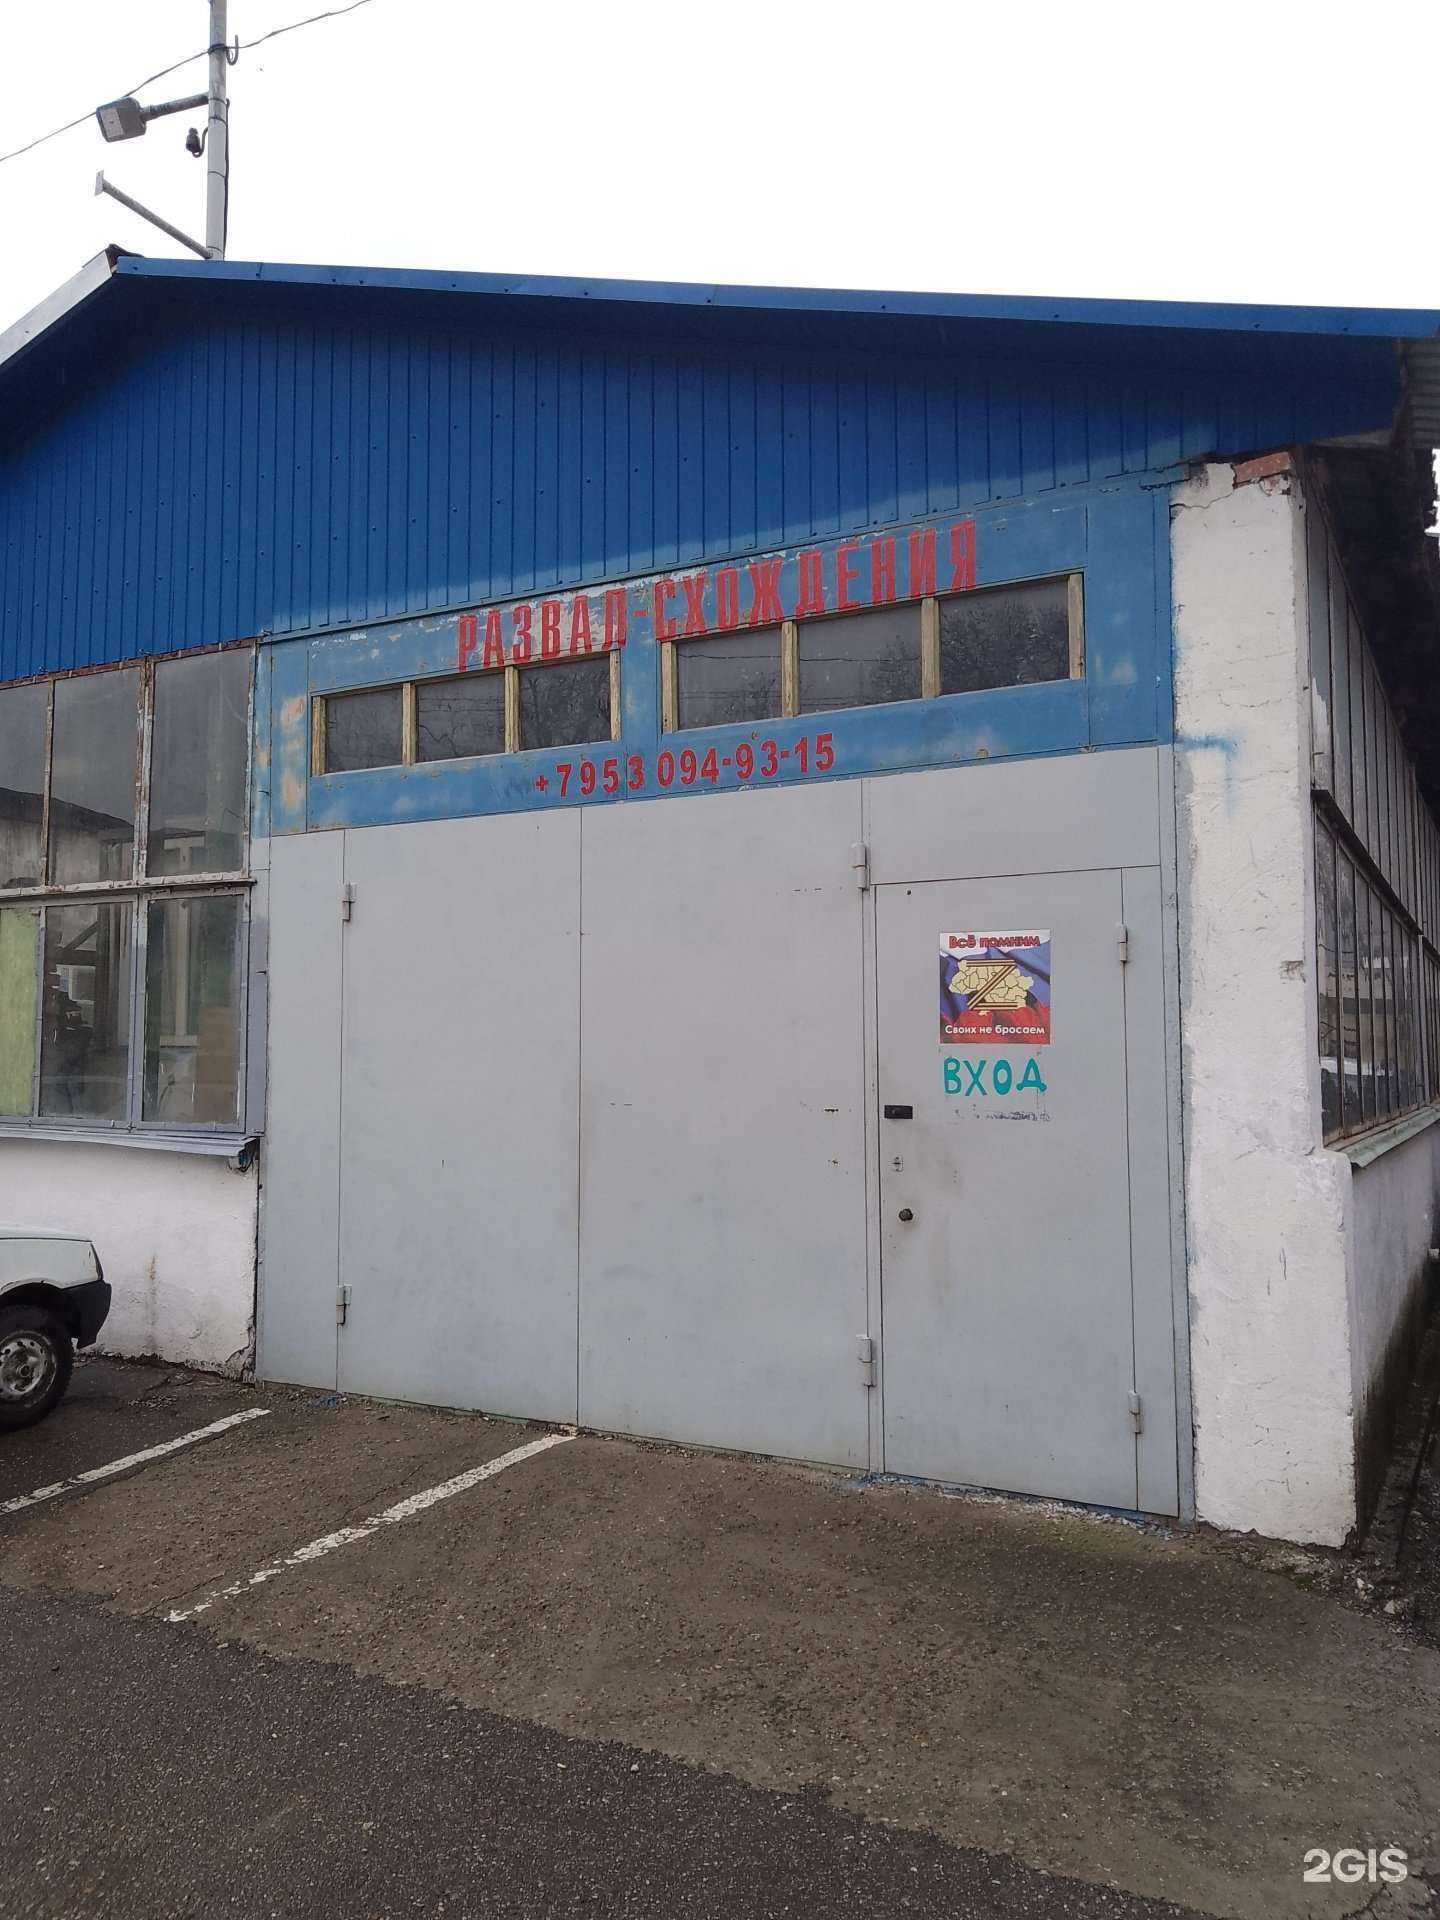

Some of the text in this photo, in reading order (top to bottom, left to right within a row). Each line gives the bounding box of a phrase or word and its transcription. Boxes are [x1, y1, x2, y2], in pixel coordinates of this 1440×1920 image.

[657, 732, 835, 788] 094-93-15
[979, 935, 1040, 948] помним
[945, 1024, 1045, 1036] Своих не бросаем
[944, 1057, 1047, 1096] ВХОД
